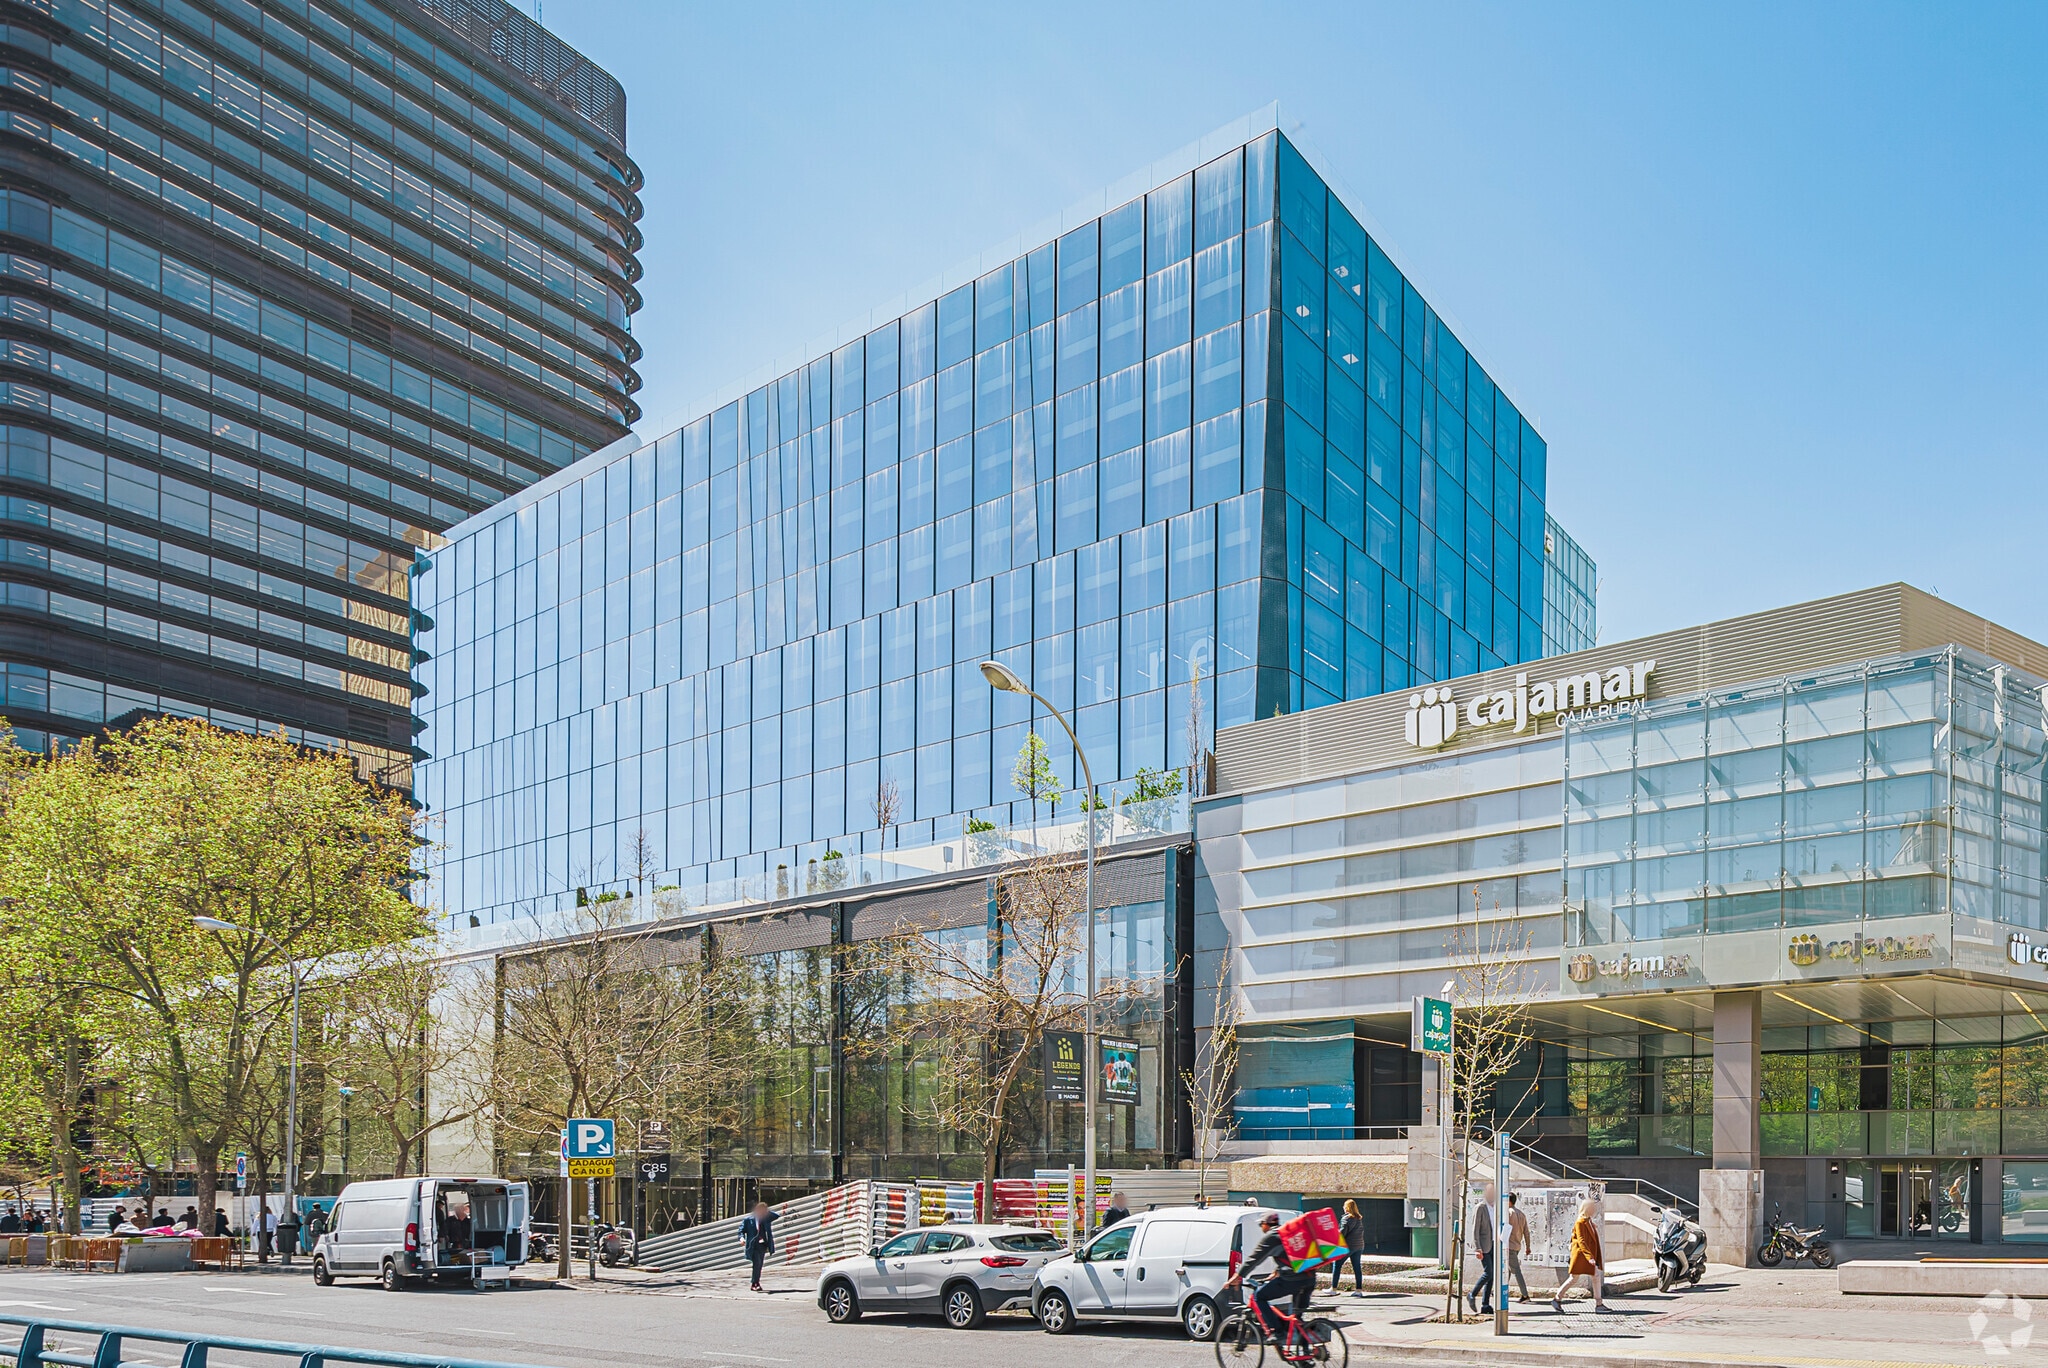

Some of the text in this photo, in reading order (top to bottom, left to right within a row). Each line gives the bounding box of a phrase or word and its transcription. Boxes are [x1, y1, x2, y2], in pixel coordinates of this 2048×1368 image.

[1467, 660, 1657, 734] cajamar
[1826, 932, 1936, 964] cajamar
[1879, 948, 1932, 962] CAJA RURAL
[1598, 952, 1690, 981] cajamar
[1052, 1060, 1081, 1070] LEGENDS
[577, 1123, 605, 1153] P
[568, 1158, 615, 1167] CADAGUA
[641, 1162, 668, 1173] C85
[572, 1167, 611, 1175] CANOE
